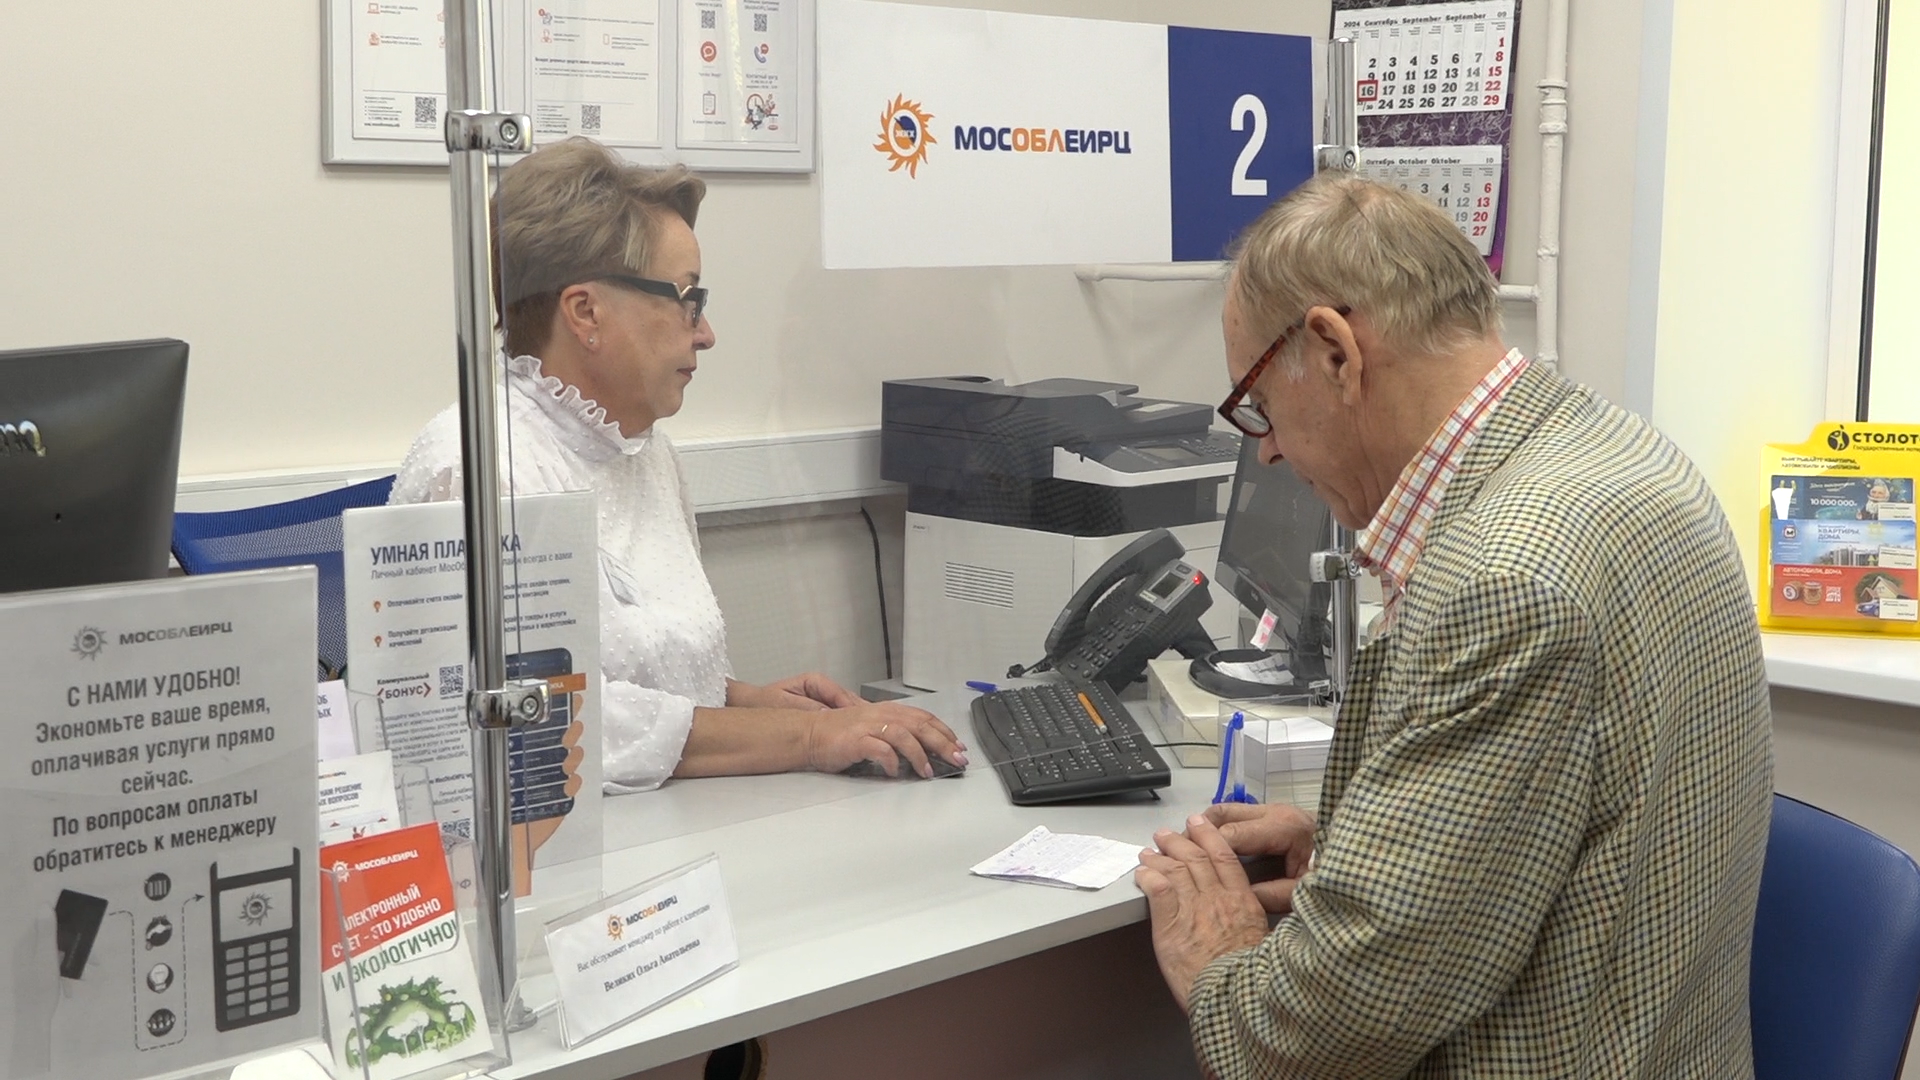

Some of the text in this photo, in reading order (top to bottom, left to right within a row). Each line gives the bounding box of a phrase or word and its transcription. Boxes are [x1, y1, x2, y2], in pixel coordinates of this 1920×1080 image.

[1364, 19, 1398, 27] Сентябрь
[1402, 15, 1442, 25] September
[1445, 13, 1486, 22] September
[1499, 37, 1505, 48] 1
[1369, 51, 1504, 68] 2 3 4 5 6 7 8
[1368, 66, 1502, 81] 9 10 11 12 13 14 15
[1361, 80, 1501, 96] 16 17 18 19 20 21 22
[1378, 99, 1394, 110] 24
[1398, 98, 1414, 109] 25
[1419, 97, 1435, 108] 26
[1441, 96, 1457, 107] 27
[1462, 95, 1479, 106] 28
[1483, 94, 1500, 106] 29
[955, 124, 1132, 154] МОСОБЛЕИРЦ
[1230, 93, 1268, 196] 2
[1366, 159, 1395, 167] Октябрь
[1421, 183, 1429, 194] 3
[1442, 183, 1449, 193] 4
[1463, 183, 1471, 193] 5
[1484, 182, 1492, 193] 6
[1438, 197, 1490, 207] 11 12 13
[1455, 211, 1488, 222] 19 20
[1472, 226, 1487, 236] 27
[1852, 432, 1920, 444] СТОЛОТ
[371, 542, 429, 566] УМНАЯ
[371, 568, 404, 579] Личный
[405, 565, 437, 576] кабинет
[523, 554, 547, 564] всегда
[555, 552, 573, 561] вами
[119, 622, 233, 645] МОСОБЛЕИРЦ
[67, 666, 241, 707] С НАМИ УДОБНО!
[385, 685, 424, 699] БОНУС
[36, 698, 271, 744] Экономьте ваше время,
[31, 726, 275, 776] оплачивая услуги прямо
[121, 768, 193, 795] сейчас.
[53, 790, 258, 838] По вопросам оплаты
[34, 815, 277, 873] обратитесь к менеджеру
[354, 850, 419, 871] МОСОБЛЕИРЦ
[344, 883, 421, 931] ЛЕКТРОННЫЙ
[392, 898, 442, 929] УДОБНО
[626, 895, 678, 926] МОСОБЛЕИРЦ
[577, 961, 590, 973] Вас
[590, 943, 627, 967] обслуживает
[627, 931, 655, 949] менеджер
[654, 927, 662, 936] по
[662, 920, 680, 935] работе
[332, 971, 345, 992] И
[604, 971, 636, 992] Великих
[636, 960, 659, 977] Ольга
